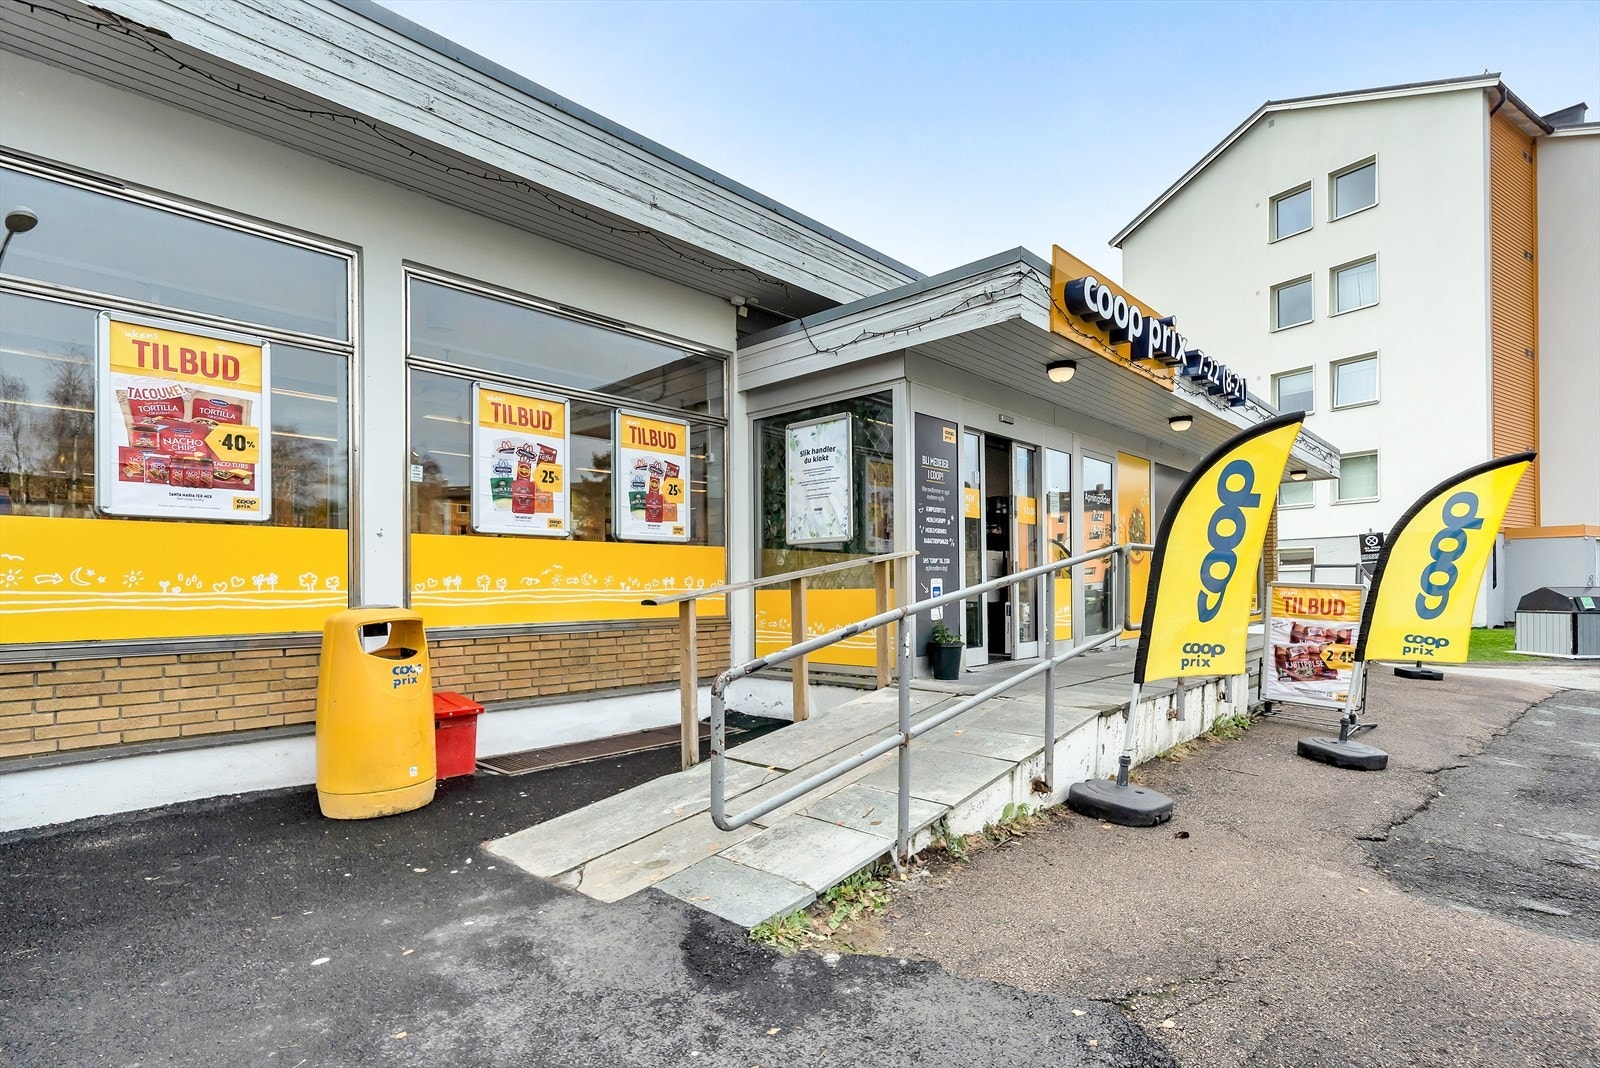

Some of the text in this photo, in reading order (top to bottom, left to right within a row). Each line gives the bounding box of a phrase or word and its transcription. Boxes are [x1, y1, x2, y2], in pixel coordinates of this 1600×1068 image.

[1083, 275, 1143, 344] coop
[1147, 314, 1188, 367] prix
[1197, 349, 1220, 387] 7-22
[131, 340, 240, 381] TILBUD
[127, 384, 186, 400] TACOUKE!
[138, 404, 178, 413] TORTILLA
[199, 407, 237, 420] TORTILLA
[491, 402, 553, 431] TILBUD
[163, 438, 204, 448] NACHO
[218, 433, 256, 452] -40%
[629, 425, 677, 450] TILBUD
[171, 444, 197, 452] CHIPS
[799, 445, 836, 458] Slik handler
[232, 462, 249, 470] TUBS
[803, 456, 812, 464] du
[236, 498, 257, 506] coop
[236, 502, 251, 510] prix
[1197, 459, 1261, 623] coop
[1415, 491, 1484, 620] coop
[1282, 596, 1346, 616] TILBUD
[1404, 634, 1450, 649] coop
[1182, 642, 1226, 658] coop
[1326, 650, 1334, 662] 2
[1402, 645, 1435, 657] prix
[1181, 657, 1211, 670] prix
[393, 675, 418, 689] prix
